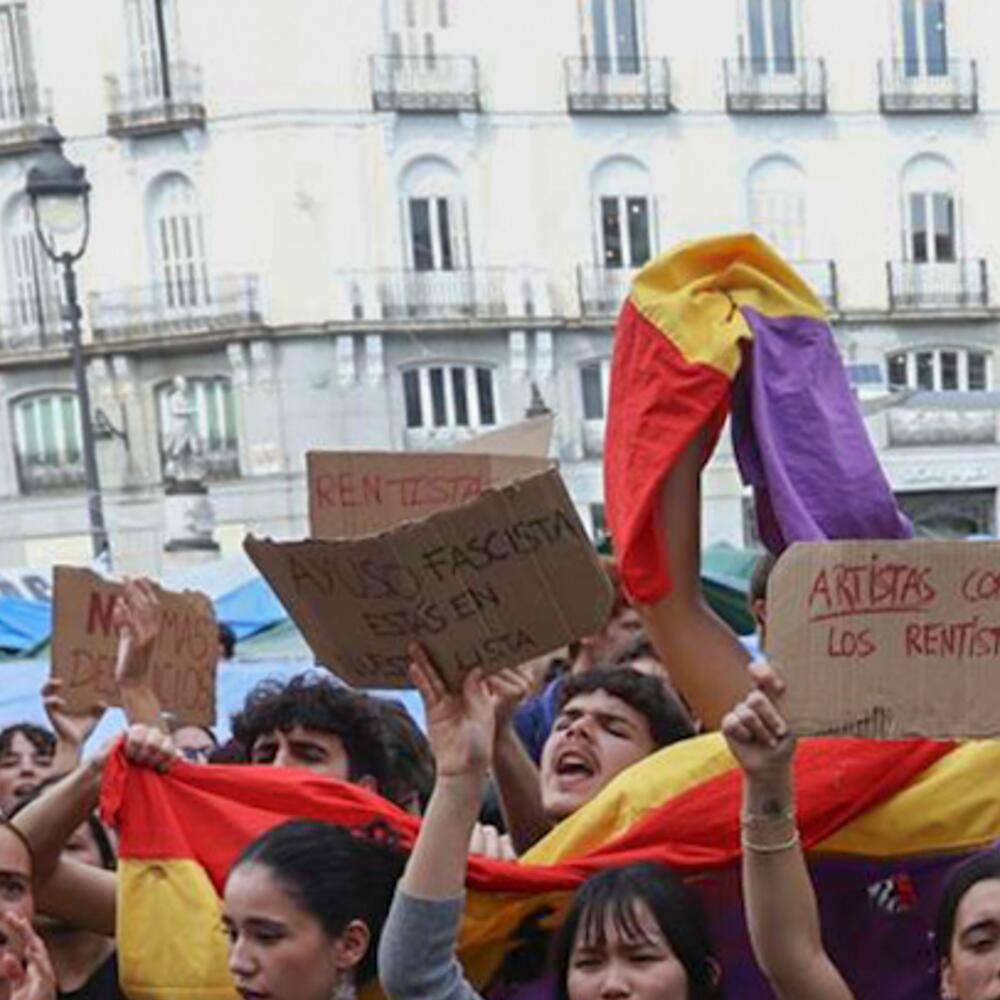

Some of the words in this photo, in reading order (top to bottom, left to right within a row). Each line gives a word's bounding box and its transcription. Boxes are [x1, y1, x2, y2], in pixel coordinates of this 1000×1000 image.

[288, 552, 422, 600] AYUSO
[421, 510, 578, 581] FASCISTA
[451, 586, 499, 621] EN
[827, 625, 878, 659] LOS
